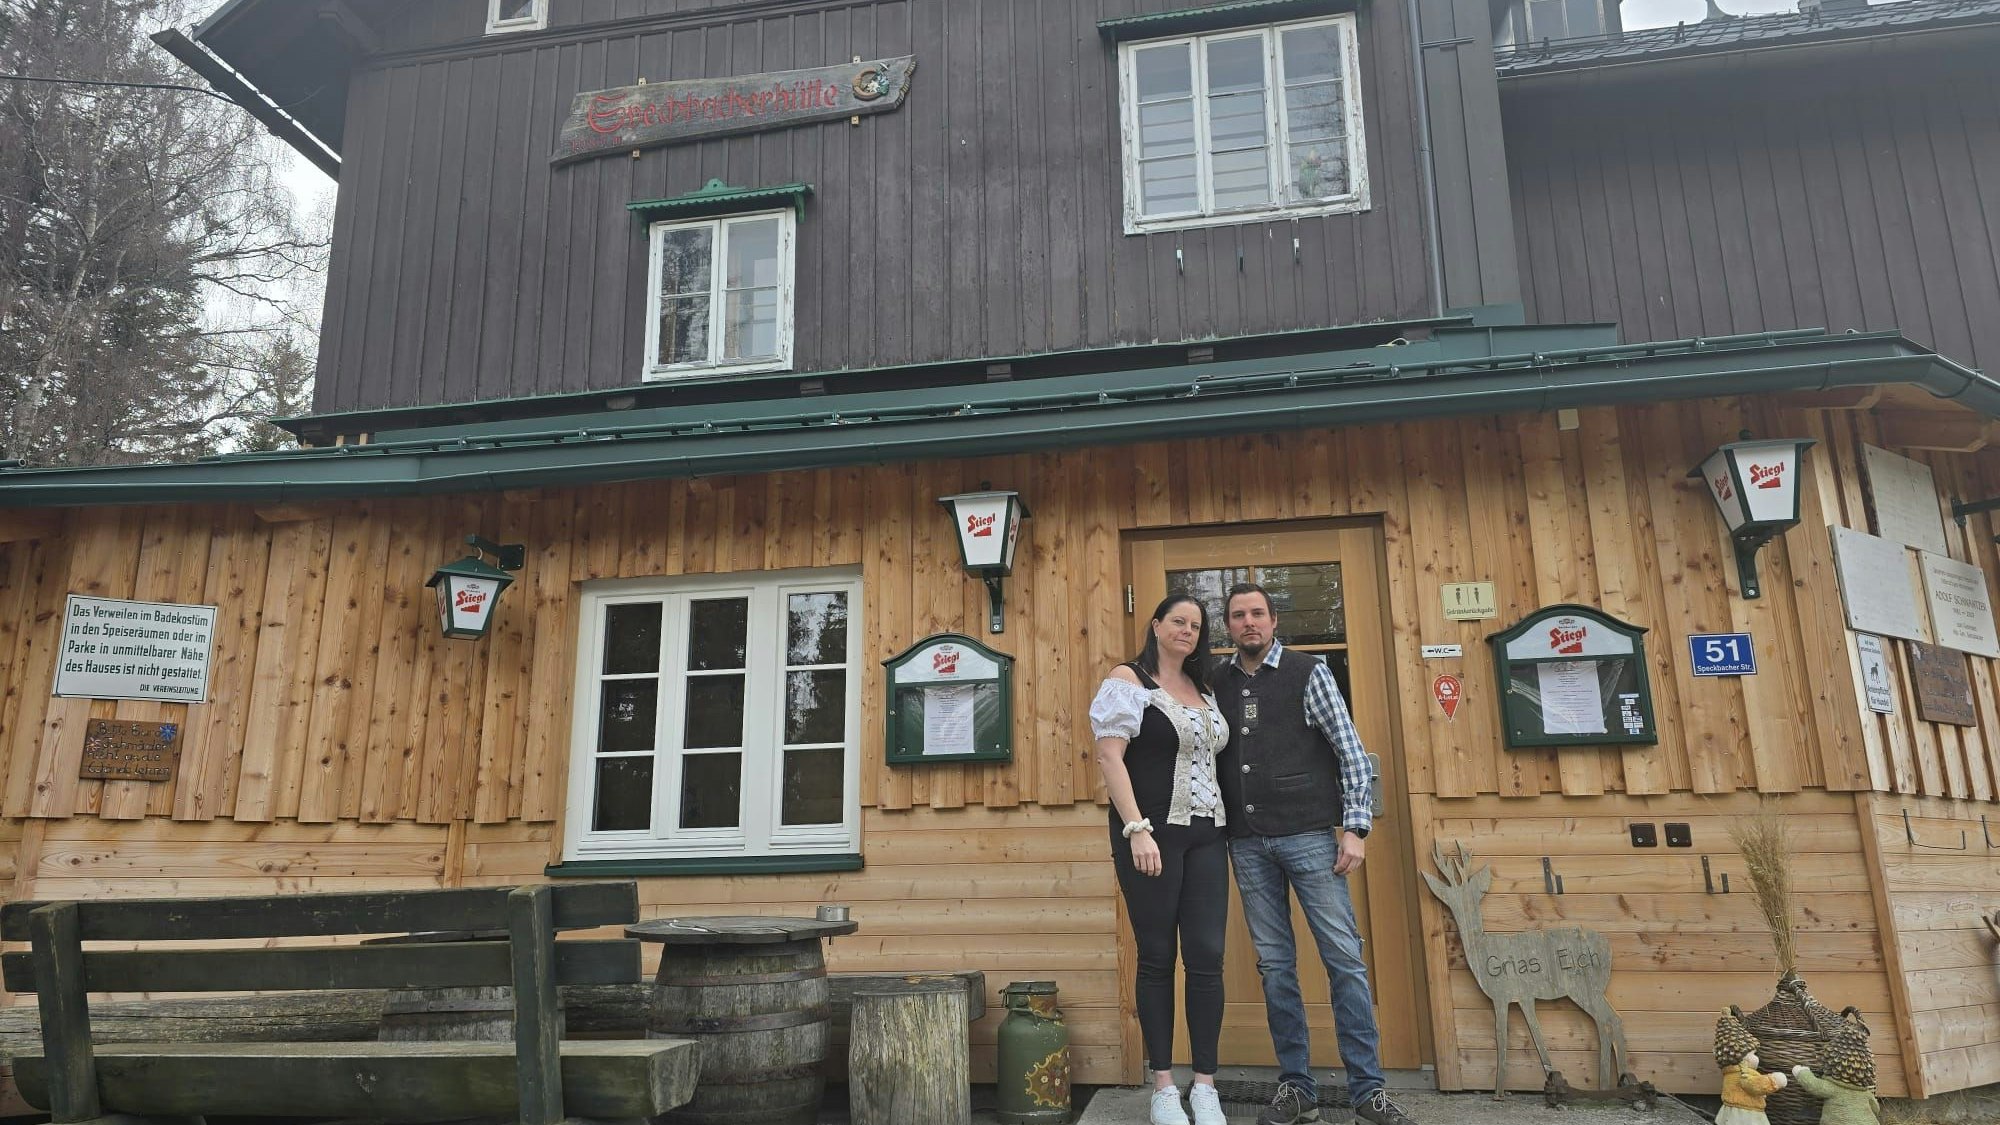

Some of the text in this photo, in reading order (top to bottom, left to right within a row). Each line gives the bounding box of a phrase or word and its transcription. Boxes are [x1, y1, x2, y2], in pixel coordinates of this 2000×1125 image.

[1749, 461, 1785, 485] Stiegl
[967, 512, 996, 534] Stiegl
[456, 590, 487, 607] Stiegl
[73, 604, 209, 627] Das Verweilen im Badekostüm
[71, 622, 207, 644] in den Speiseräumen oder im
[1550, 625, 1587, 649] Stiegl
[68, 640, 204, 661] Parke in unmittelbarer Nähe
[933, 651, 960, 669] Stiegl
[1705, 639, 1740, 663] 51
[65, 658, 83, 672] des
[85, 660, 121, 674] Hauses
[122, 662, 136, 675] ist
[137, 663, 160, 676] nicht
[1697, 663, 1752, 673] Speckbacher Str.
[140, 683, 199, 695] DIE VEREINSLEITUNG
[1486, 947, 1601, 977] Grias Eich
